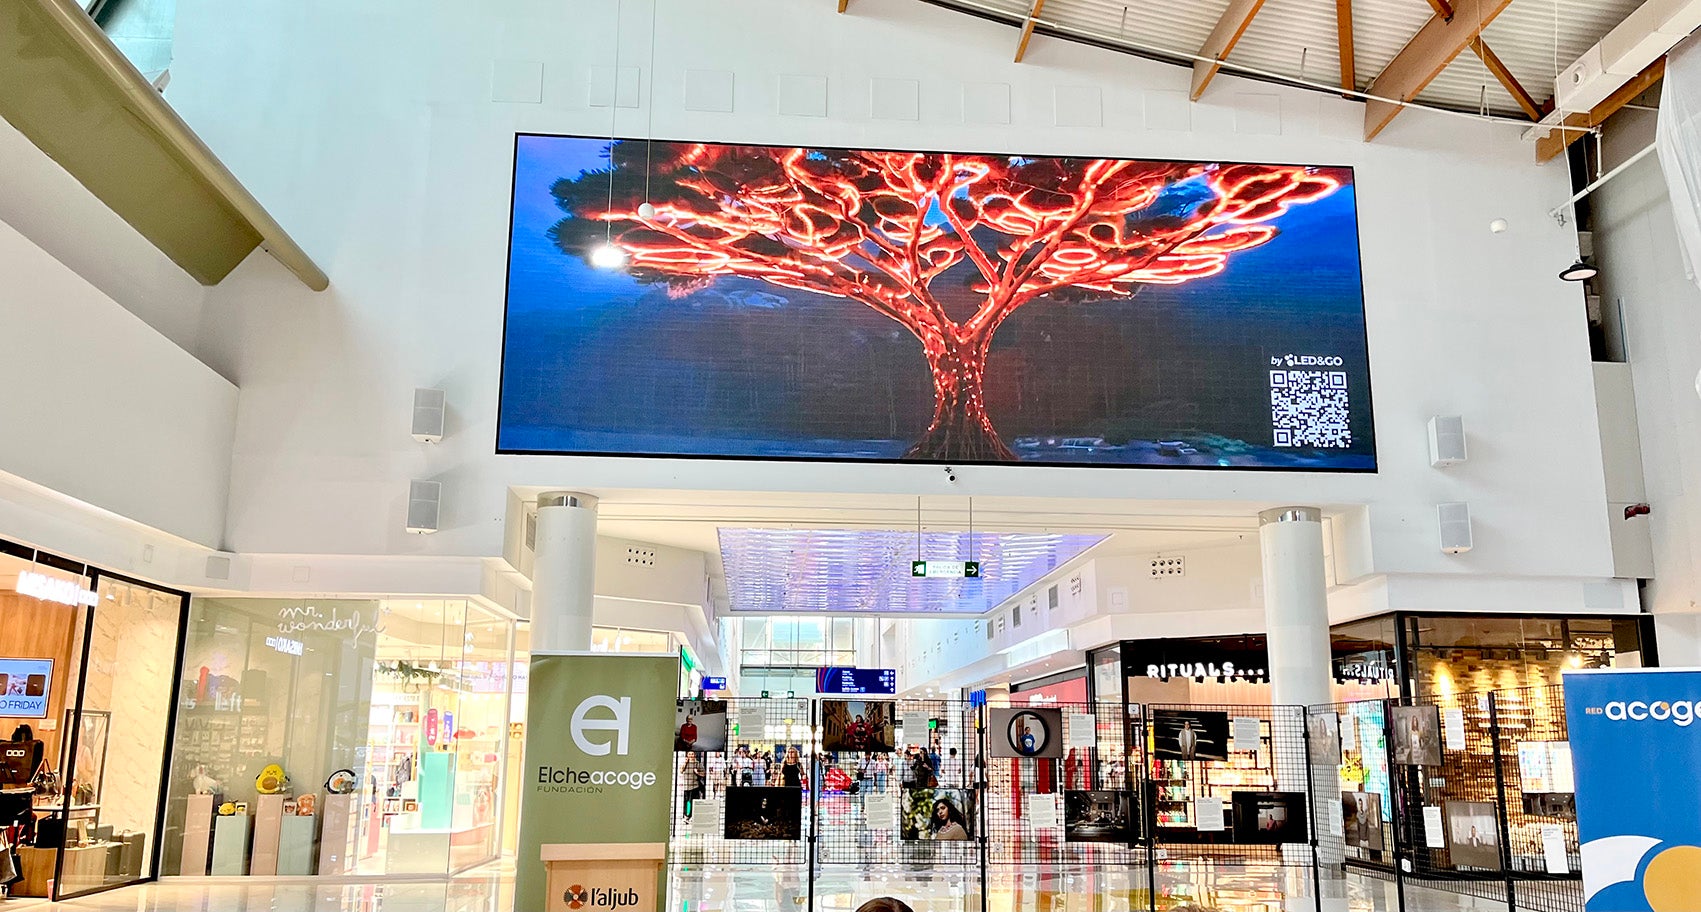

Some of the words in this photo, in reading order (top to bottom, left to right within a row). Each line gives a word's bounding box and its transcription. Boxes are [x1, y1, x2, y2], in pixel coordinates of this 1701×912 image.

[1270, 355, 1283, 367] by
[1294, 356, 1343, 367] LED&GO
[8, 700, 42, 710] FRIDAY
[1585, 707, 1603, 715] RED
[538, 766, 656, 790] Elcheacoge
